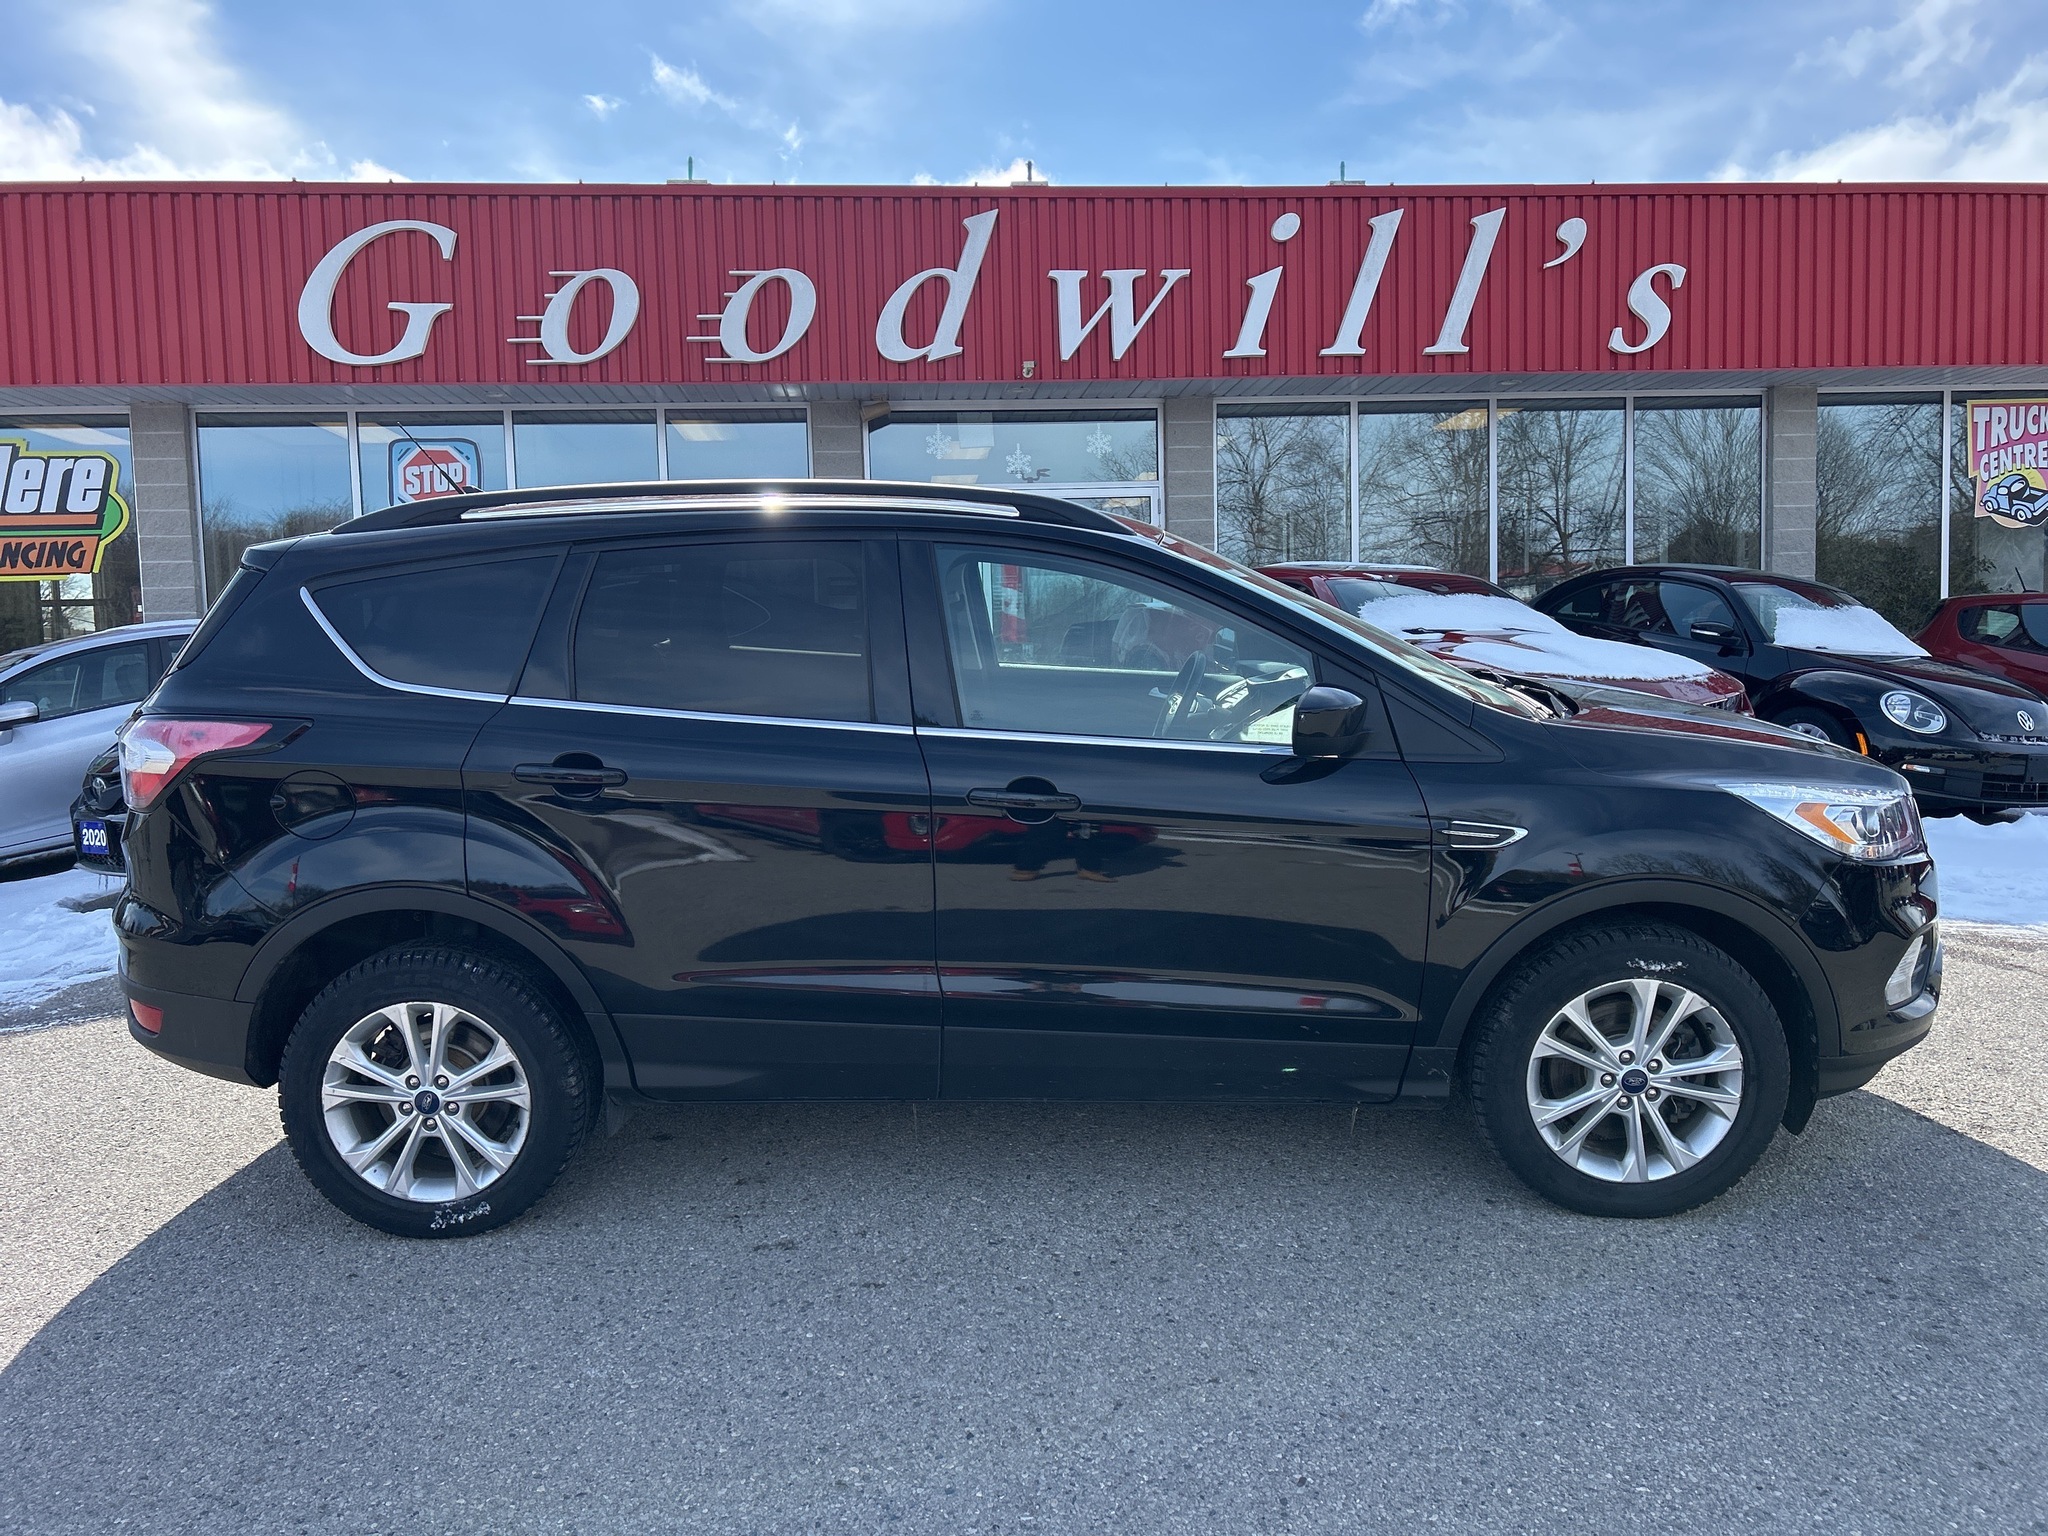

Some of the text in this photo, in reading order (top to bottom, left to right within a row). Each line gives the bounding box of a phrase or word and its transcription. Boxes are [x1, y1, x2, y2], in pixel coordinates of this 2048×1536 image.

[297, 206, 1687, 367] Goodwill's
[405, 462, 463, 495] STOP
[1980, 441, 2048, 482] CENTRE
[82, 828, 107, 847] 2020
